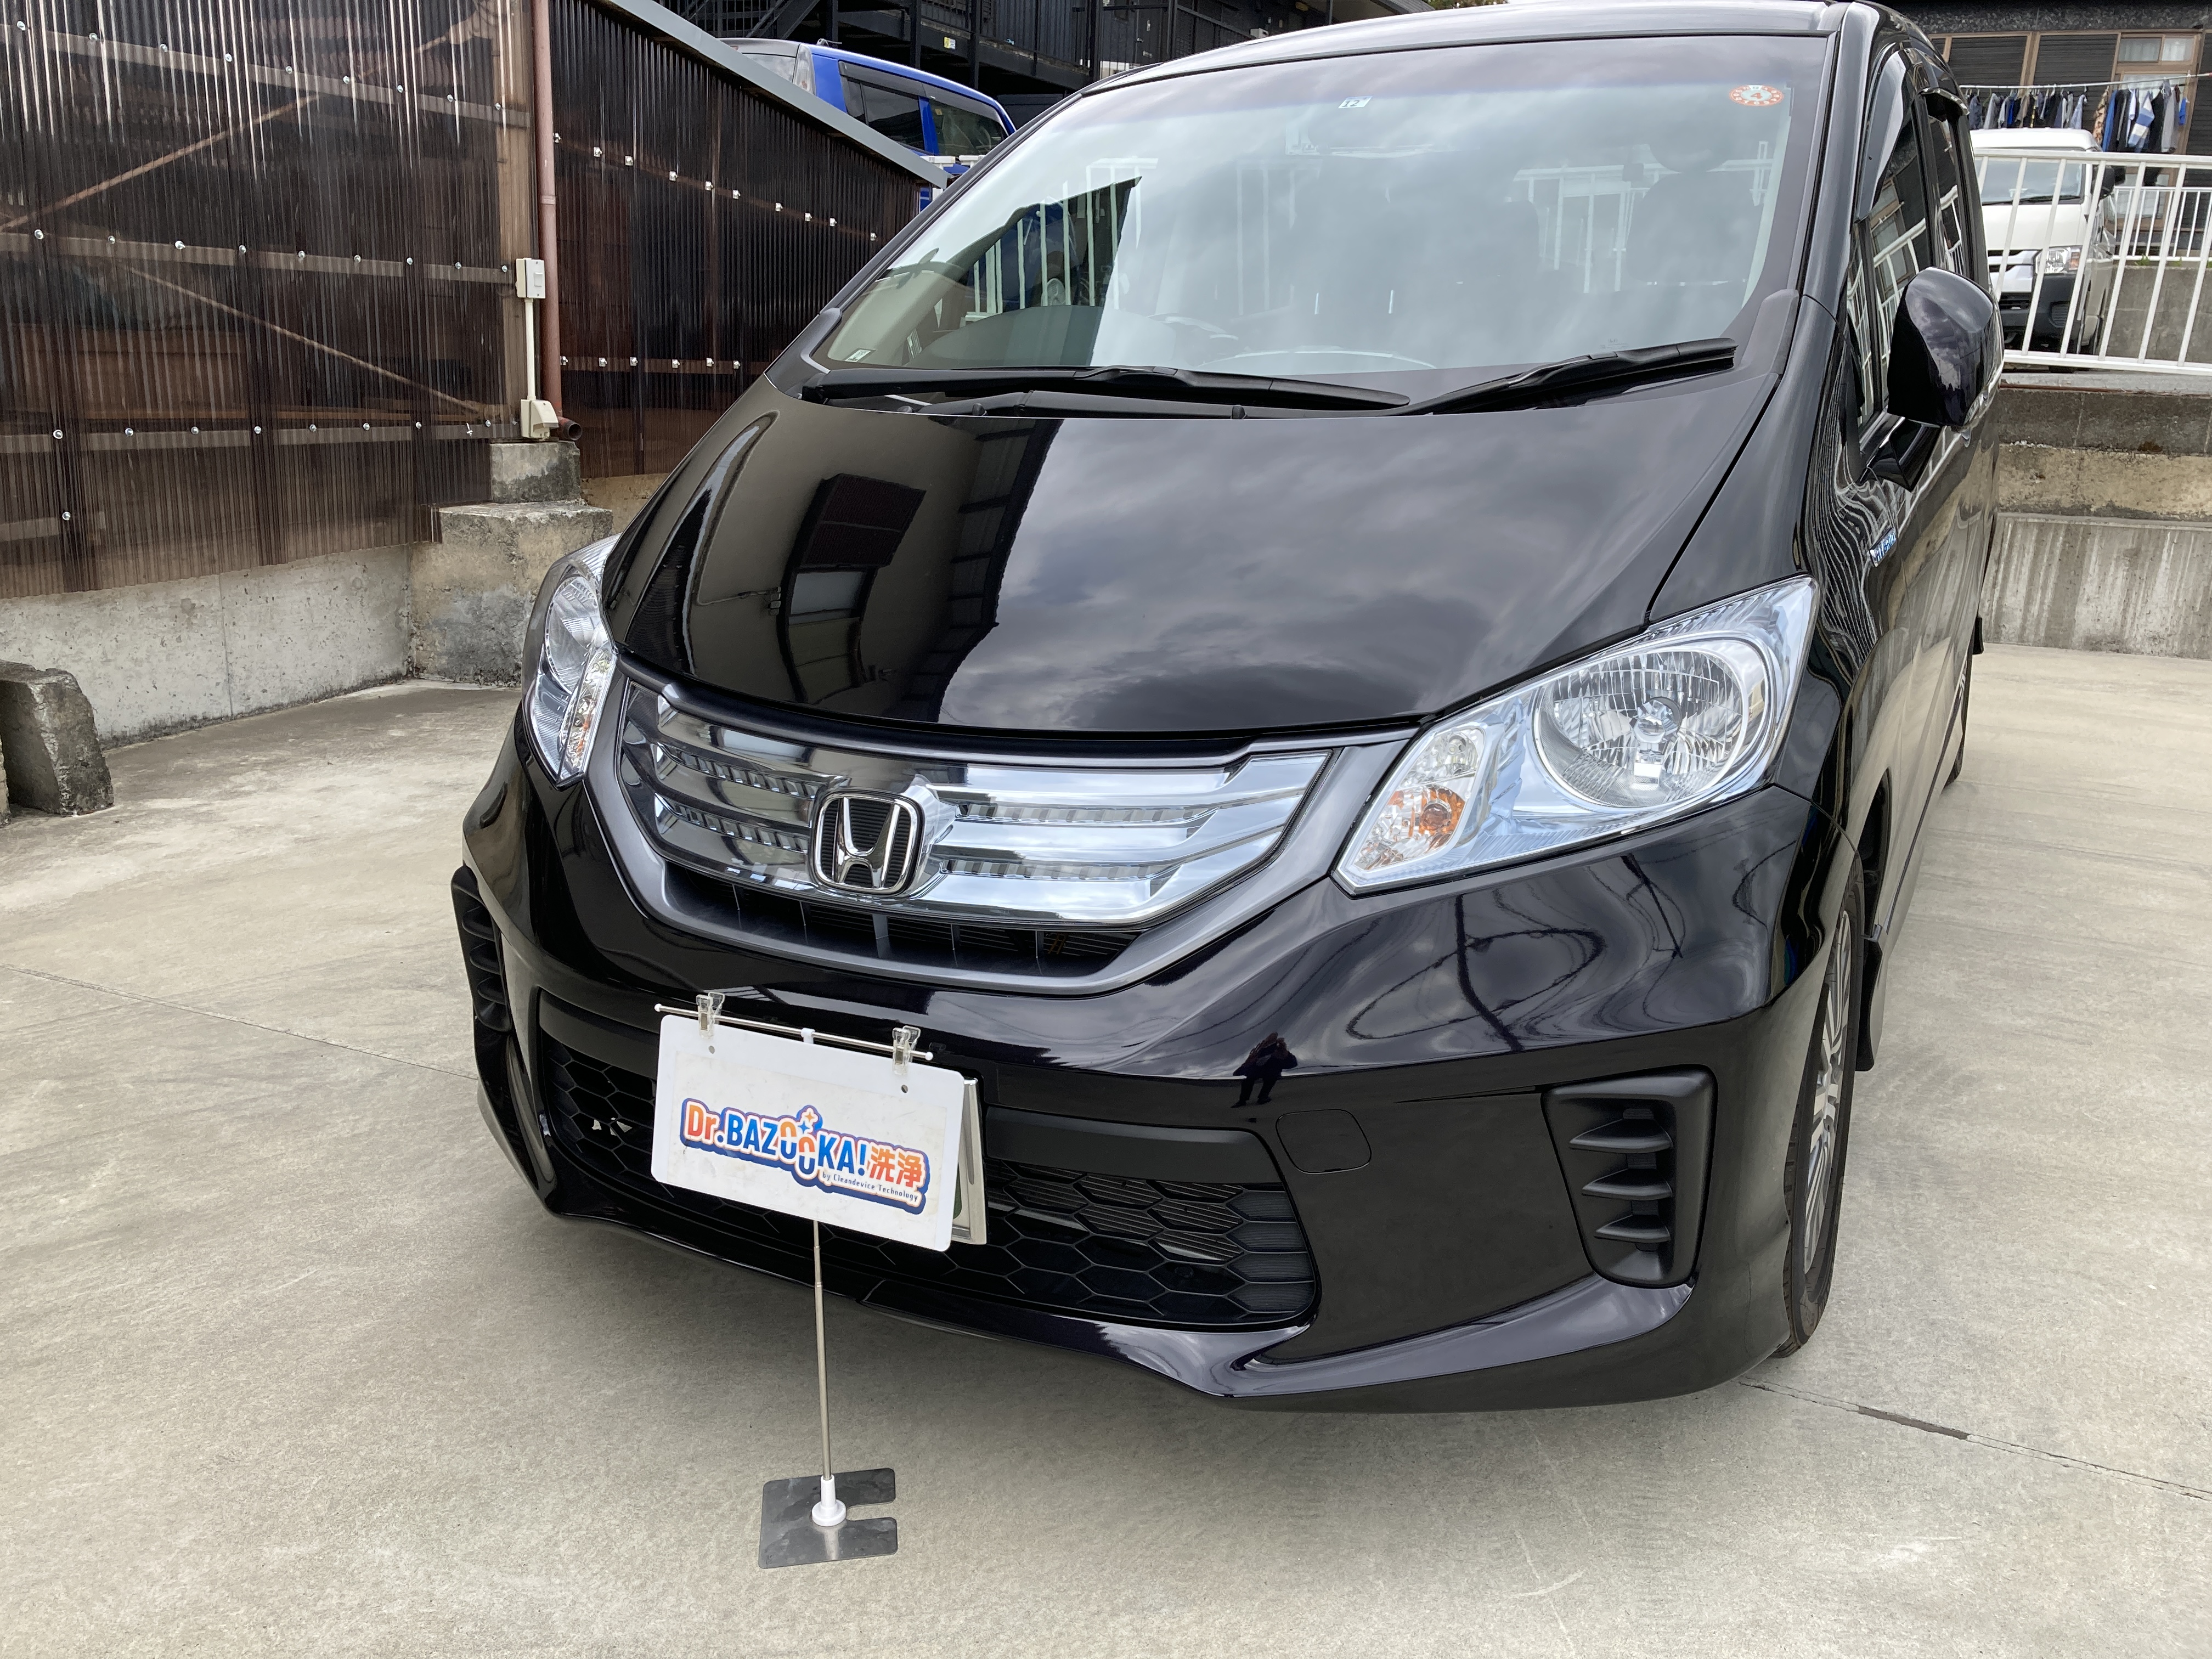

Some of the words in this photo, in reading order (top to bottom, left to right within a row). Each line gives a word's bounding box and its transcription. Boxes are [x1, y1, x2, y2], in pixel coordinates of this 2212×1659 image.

[822, 1171, 831, 1181] by
[833, 1173, 876, 1190] Cleandevice
[878, 1184, 918, 1203] Technology
